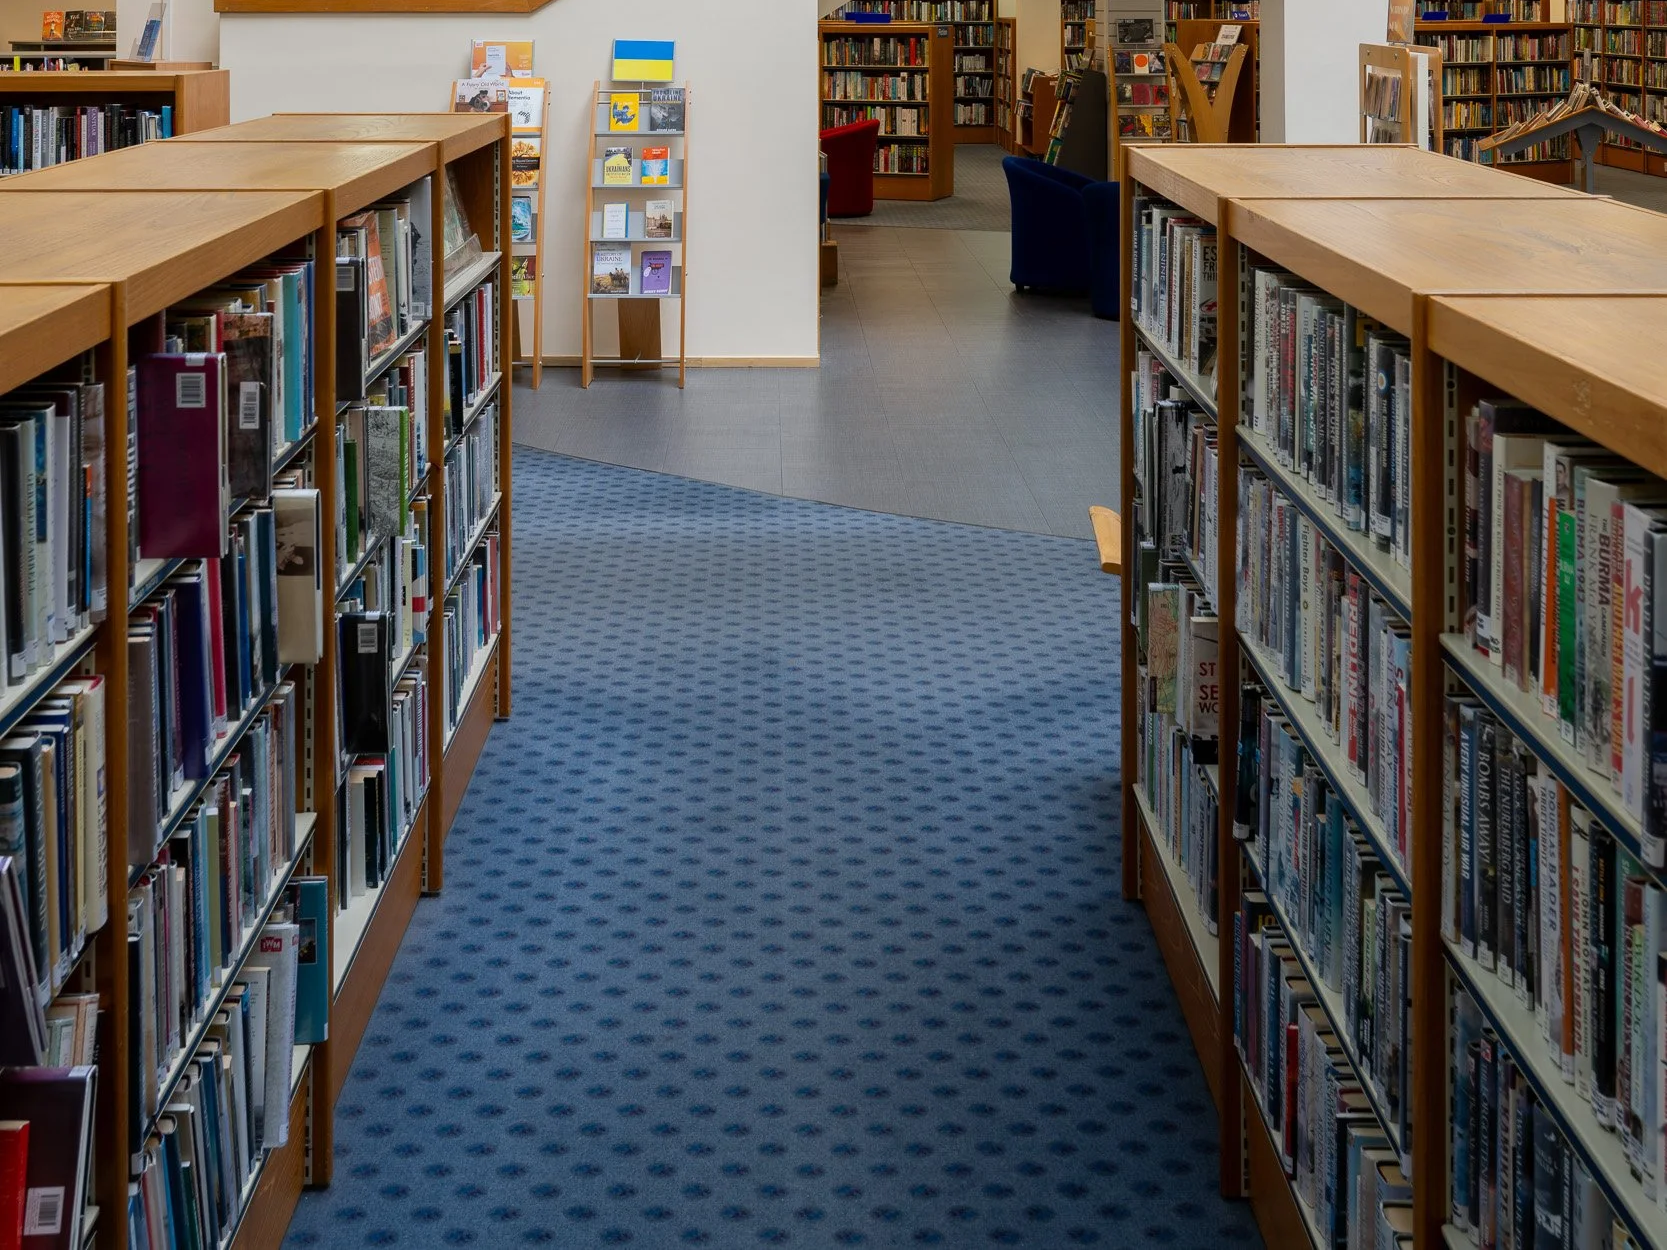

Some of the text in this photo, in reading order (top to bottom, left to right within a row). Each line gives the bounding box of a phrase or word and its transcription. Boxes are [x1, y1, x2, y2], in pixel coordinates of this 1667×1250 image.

[1319, 371, 1324, 387] WE
[1319, 409, 1324, 422] AS
[1403, 470, 1409, 483] to
[27, 472, 36, 597] GERALD O'FARRELL
[1577, 499, 1585, 603] BURMA 1942
[1588, 513, 1598, 561] FRANK
[1598, 533, 1611, 606] BURMA
[1612, 582, 1623, 756] ANOTHER MAN'S WAR
[1643, 574, 1652, 730] PEARL HARBOR
[34, 754, 49, 931] ROMAN BRITAIN
[1461, 731, 1470, 879] A VERY UNUSUAL AIR WAR
[1477, 751, 1490, 863] BOMBS AWAY!
[1501, 767, 1512, 904] THE NUREMBERG RAID
[1548, 790, 1557, 932] DOUGLAS BADER
[262, 938, 281, 951] IWM
[1634, 990, 1643, 1035] DOG
